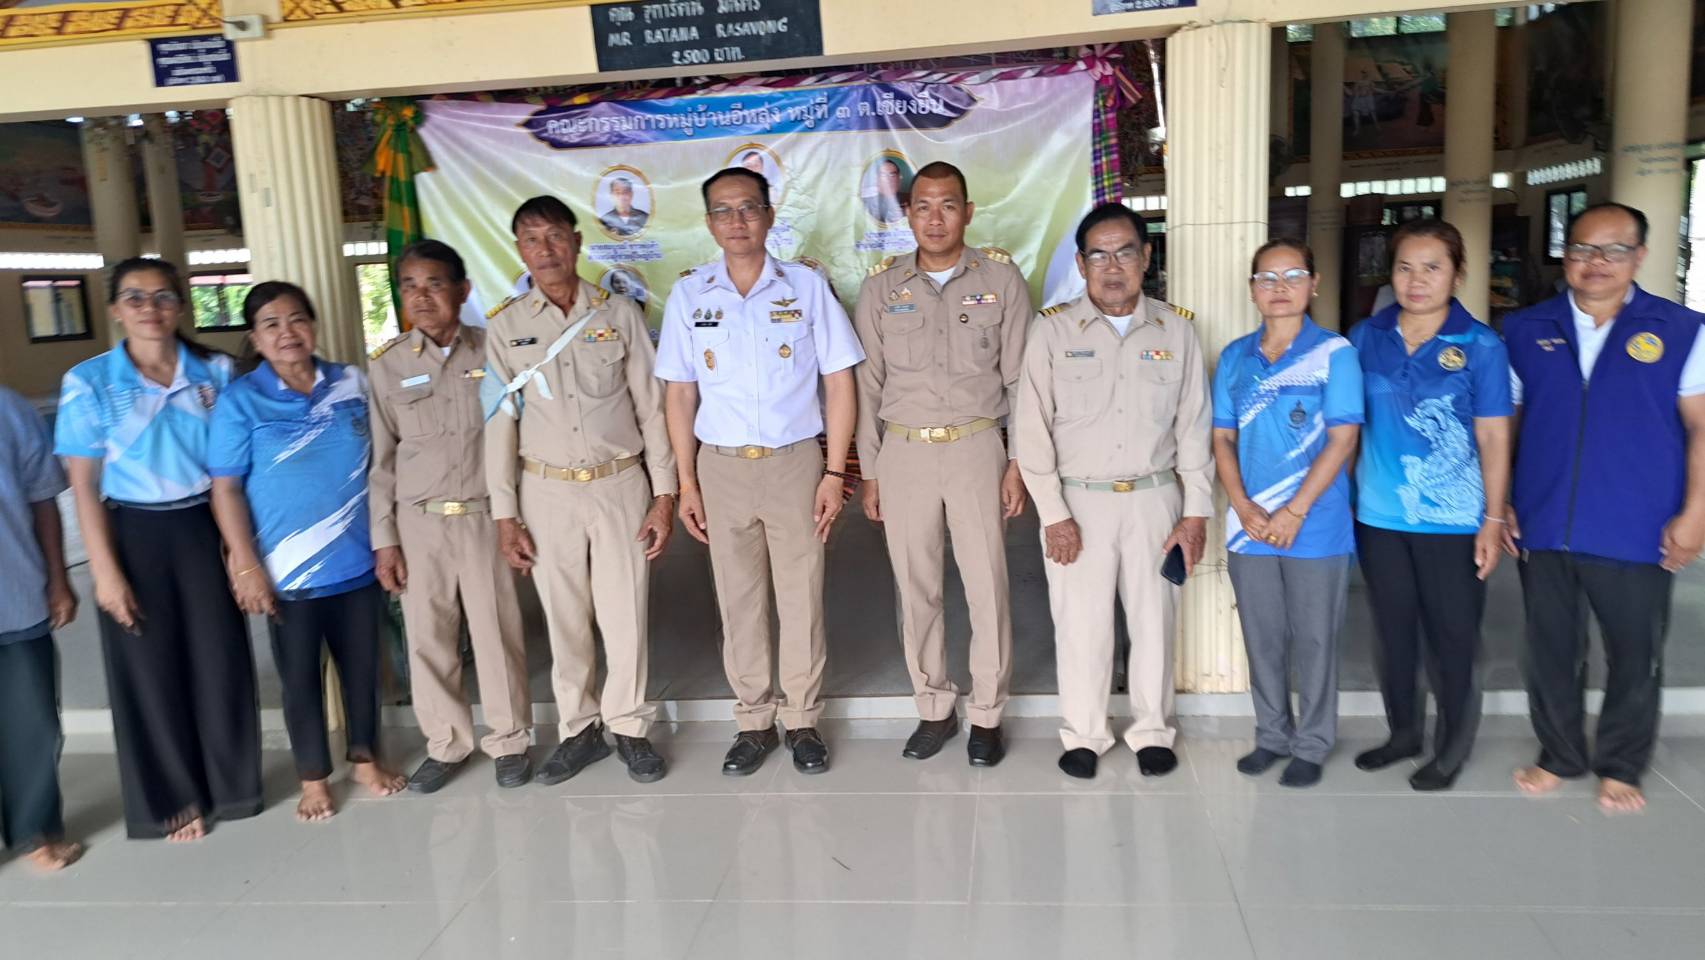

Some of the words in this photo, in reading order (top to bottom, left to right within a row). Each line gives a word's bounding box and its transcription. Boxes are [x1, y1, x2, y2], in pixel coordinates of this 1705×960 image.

[644, 25, 699, 44] RATANA
[716, 17, 788, 38] RASAVONG
[788, 92, 829, 129] หมู่ที่
[835, 106, 851, 119] ๓
